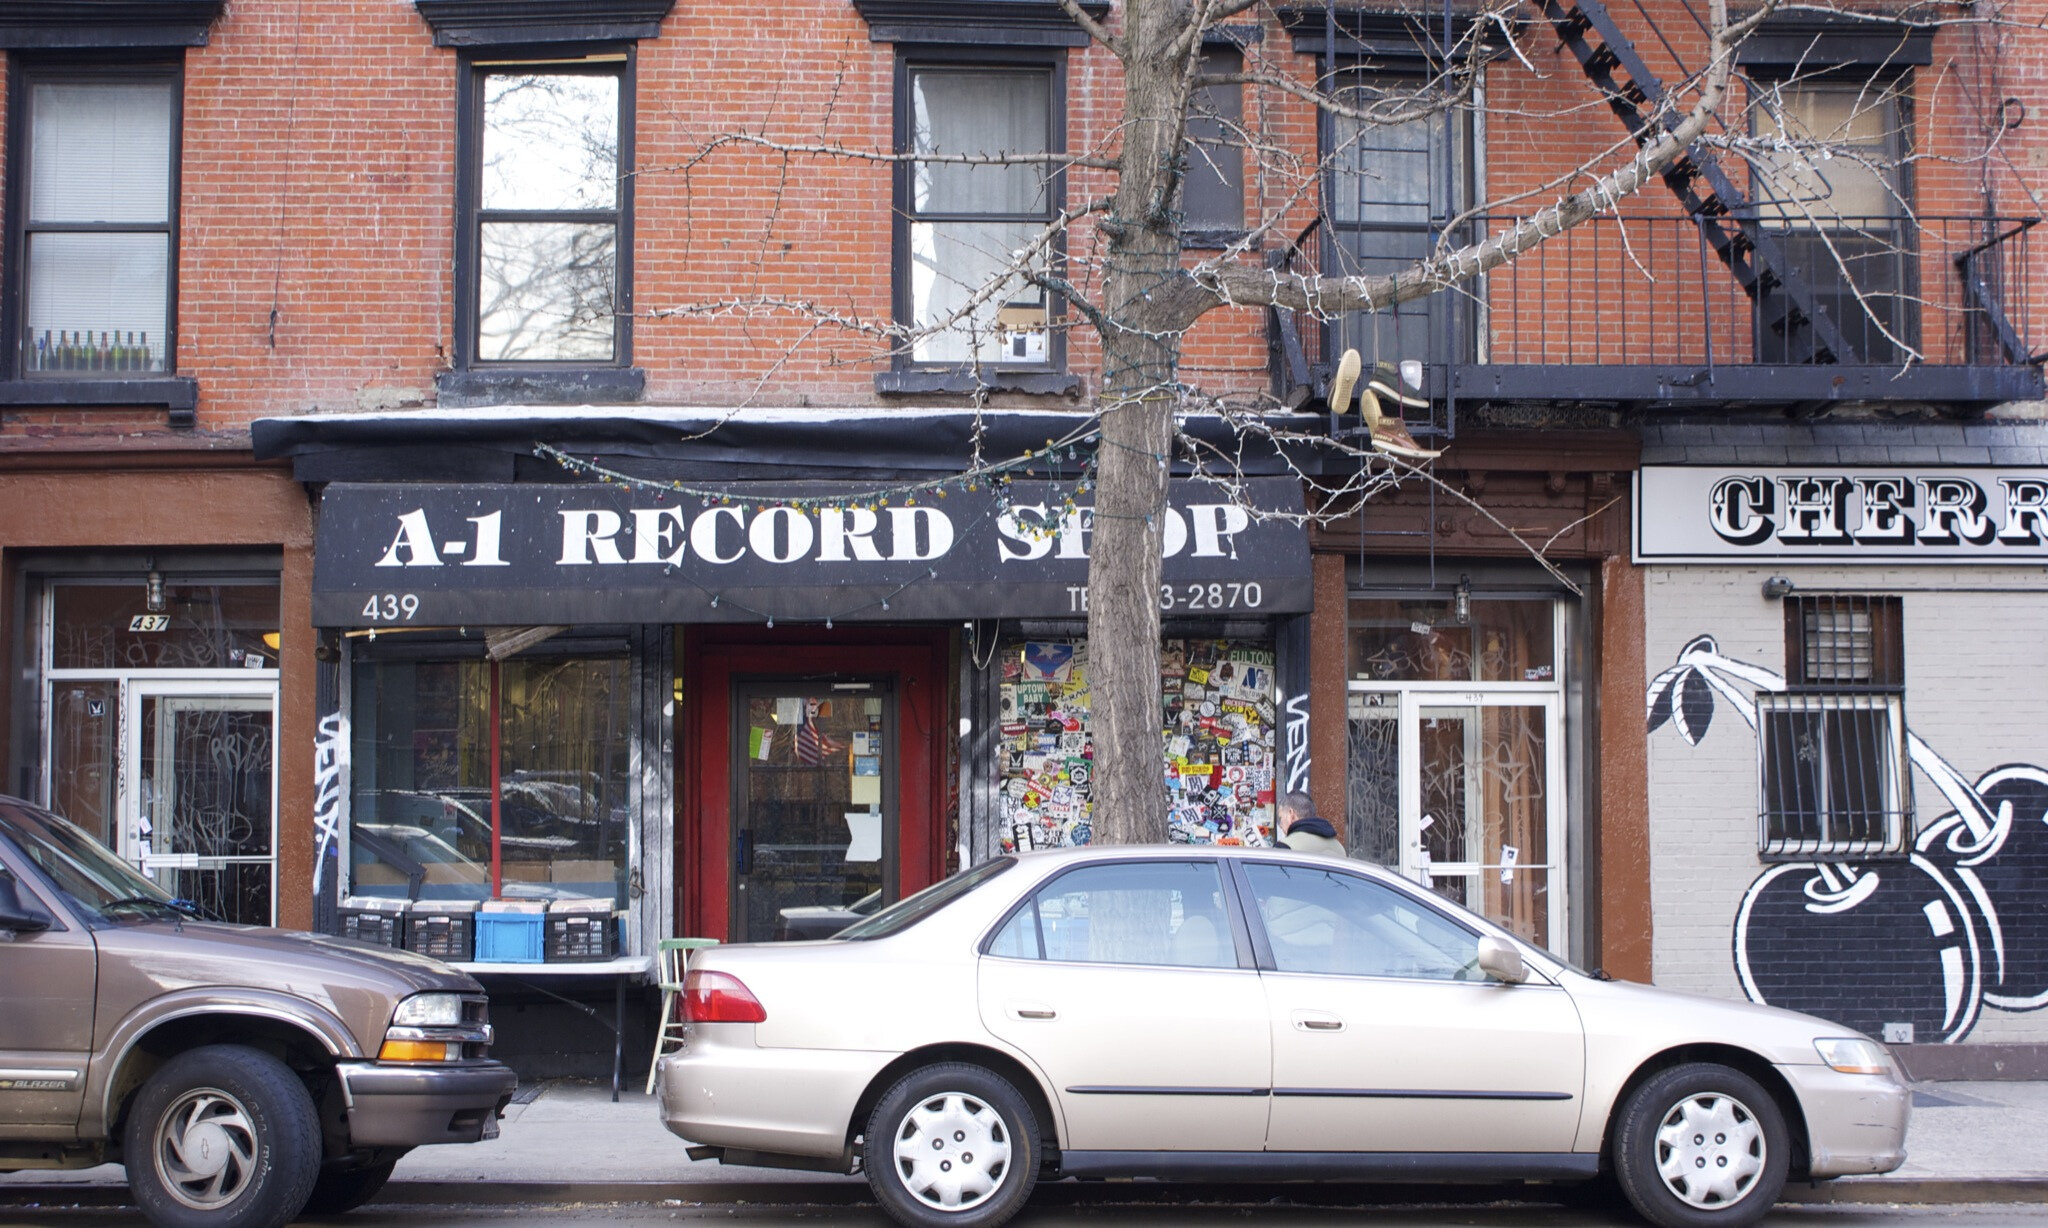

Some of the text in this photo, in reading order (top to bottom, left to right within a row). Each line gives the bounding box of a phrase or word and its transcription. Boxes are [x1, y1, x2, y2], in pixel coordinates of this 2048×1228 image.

[375, 508, 510, 566] A-1
[556, 504, 953, 567] RECORD
[362, 594, 419, 620] 439
[131, 616, 169, 630] 437
[1230, 650, 1272, 665] FULTON
[1024, 694, 1043, 703] BABY
[1465, 692, 1484, 703] 439
[13, 1080, 67, 1089] BLAZER
